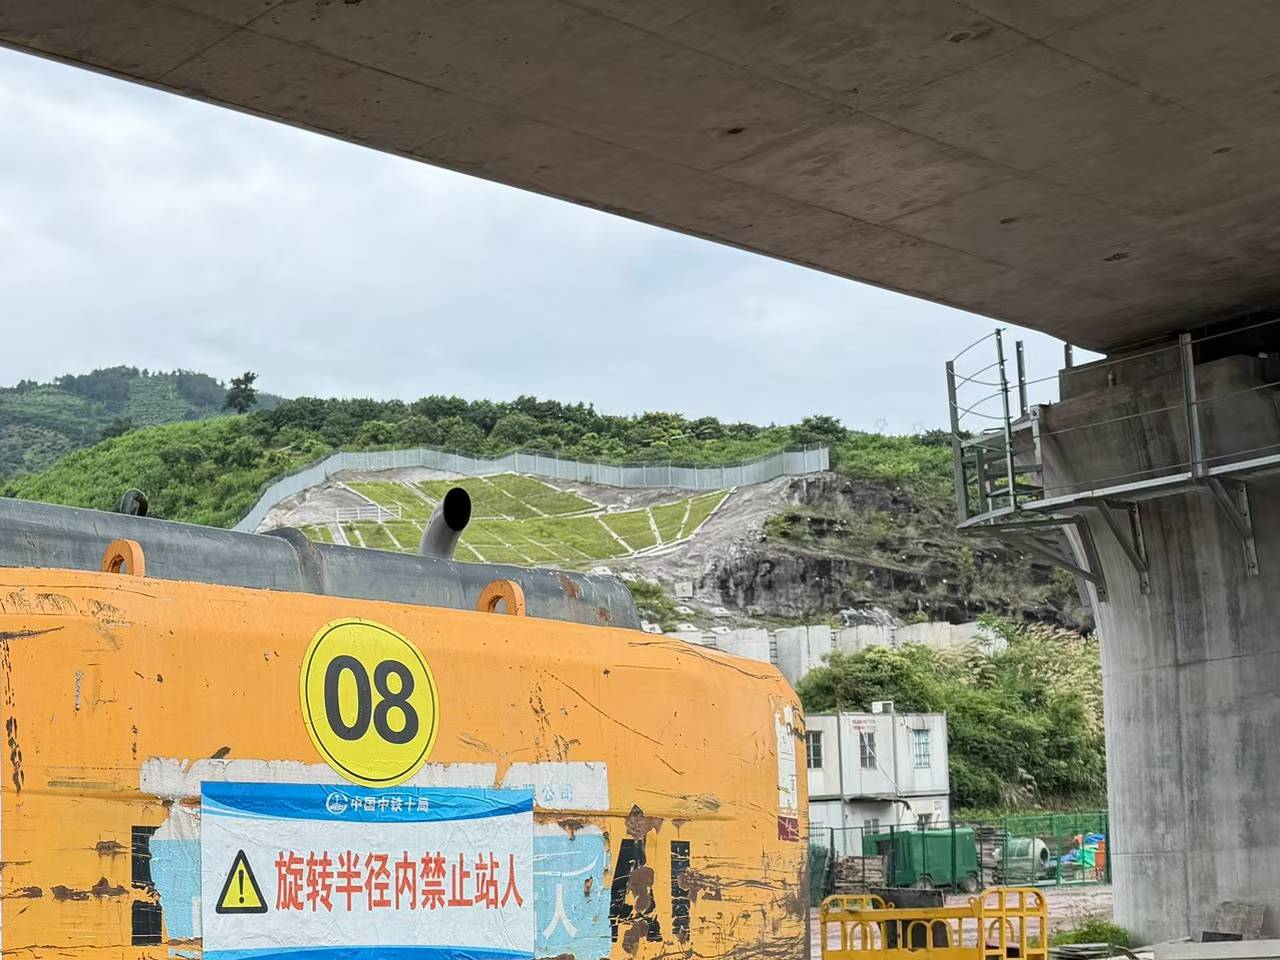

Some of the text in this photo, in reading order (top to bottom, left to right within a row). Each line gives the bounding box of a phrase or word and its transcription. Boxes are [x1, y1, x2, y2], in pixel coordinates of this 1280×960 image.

[324, 654, 420, 745] 08
[350, 796, 430, 813] 中国中铁十局
[274, 849, 524, 913] 旋转半径内禁止站人
